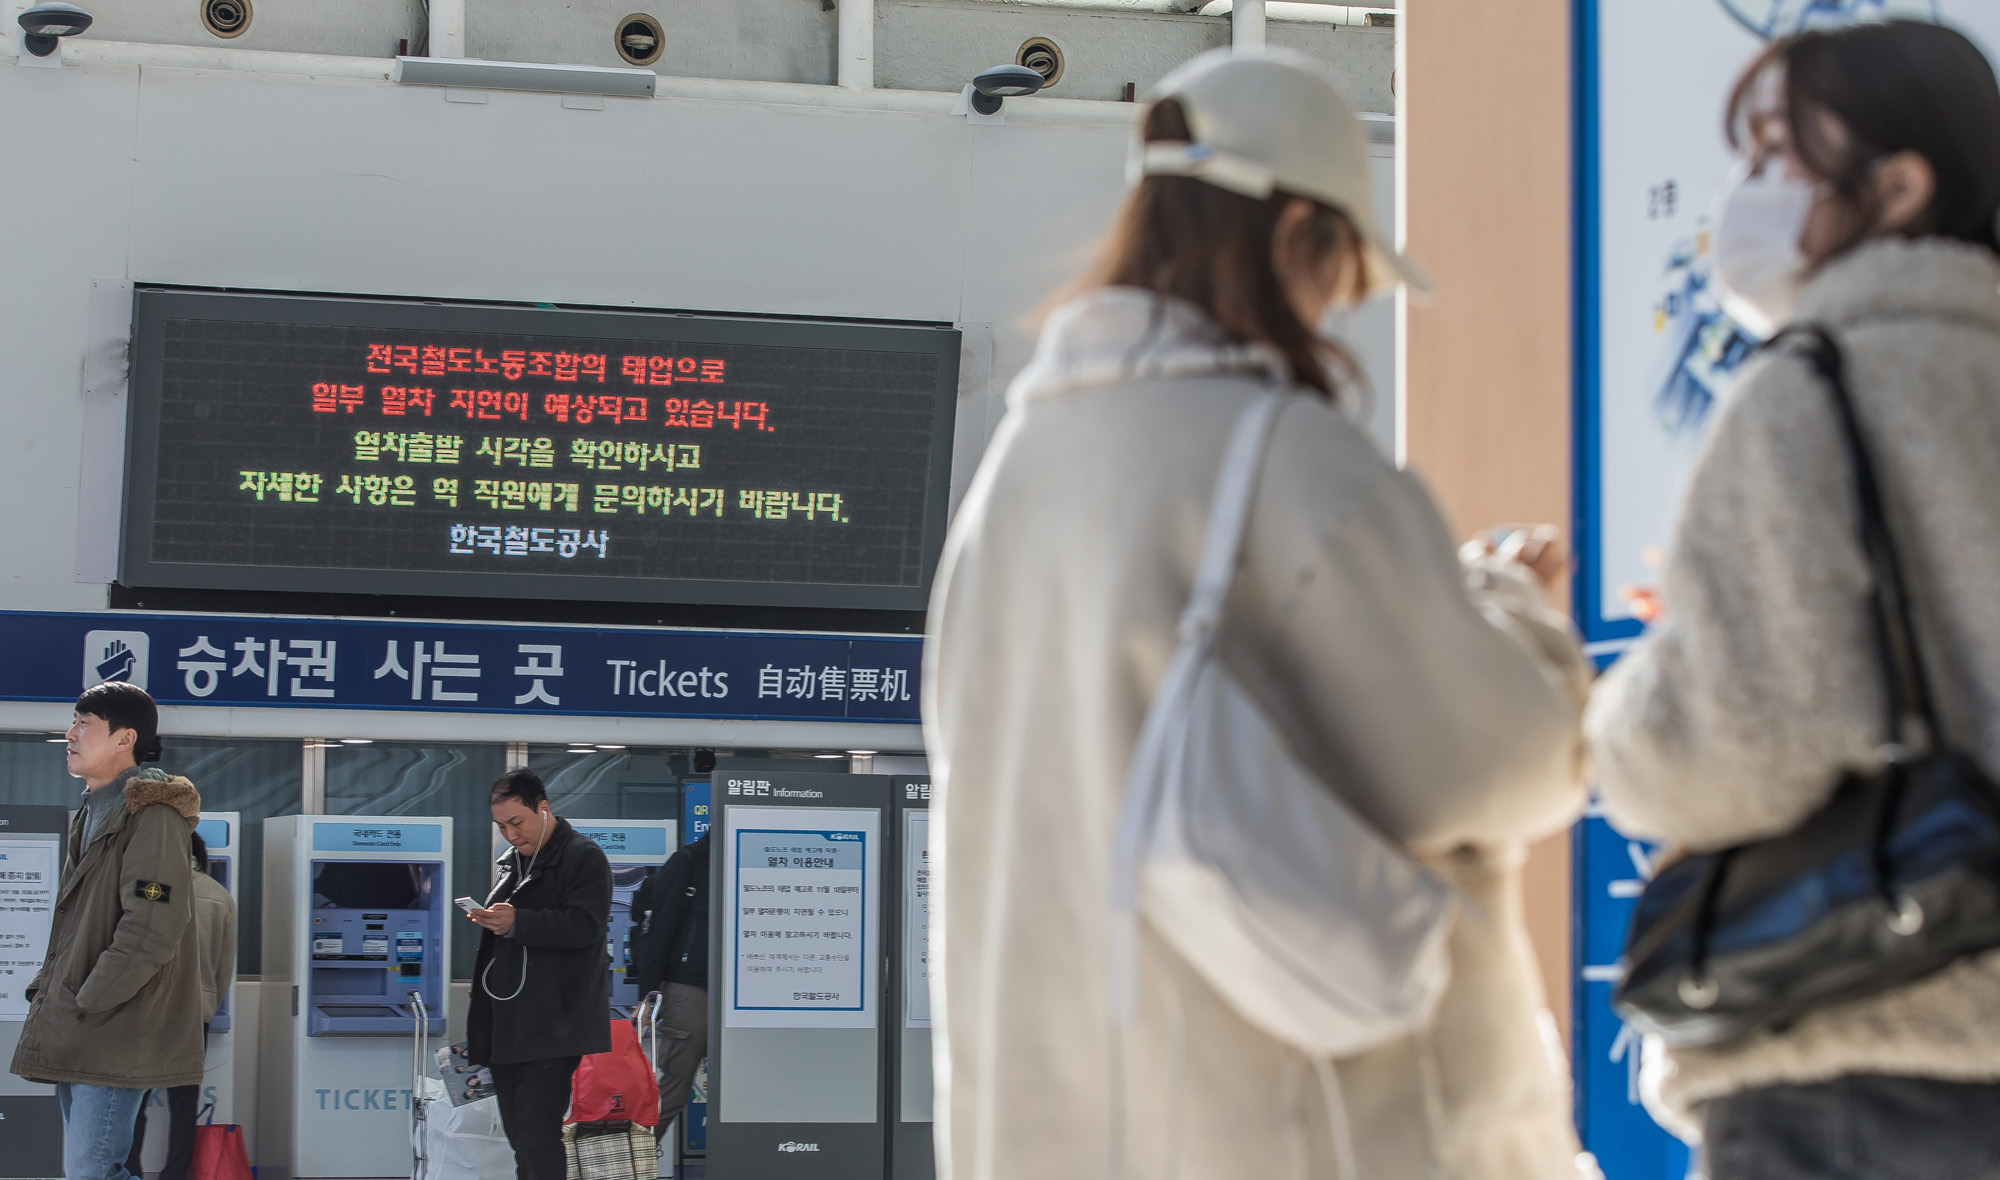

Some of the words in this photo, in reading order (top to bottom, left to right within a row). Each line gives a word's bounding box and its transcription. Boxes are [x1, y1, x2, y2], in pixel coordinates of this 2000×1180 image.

[366, 343, 607, 383] 전국철도노동조합의
[621, 355, 725, 386] 태업으로
[312, 382, 364, 414] 일부
[380, 385, 436, 417] 열차
[449, 389, 529, 421] 지연이
[543, 393, 648, 425] 예상되고
[664, 397, 775, 432] 있습니다.
[354, 430, 464, 464] 열차출발
[475, 436, 555, 468] 시각을
[569, 437, 701, 473] 확인하시고
[239, 470, 324, 503] 자세한
[335, 474, 417, 506] 사항은
[432, 477, 459, 508] 역
[473, 479, 579, 512] 직원에게
[593, 484, 725, 517] 문의하시기
[738, 489, 849, 523] 바랍니다.
[449, 523, 610, 559] 한국철도공사
[176, 635, 337, 698] 승차권
[373, 640, 481, 702] 사는
[514, 643, 564, 706] 곳
[606, 659, 729, 699] Tickets
[758, 663, 912, 702] 自动售票机
[727, 779, 771, 796] 알림판
[773, 787, 823, 799] Information
[693, 804, 709, 816] QR
[353, 828, 384, 839] 국내카드
[386, 829, 402, 839] 전용
[611, 833, 626, 842] 전용
[767, 856, 789, 868] 열차
[792, 857, 834, 868] 이용안내
[778, 1141, 820, 1152] KORAIL
